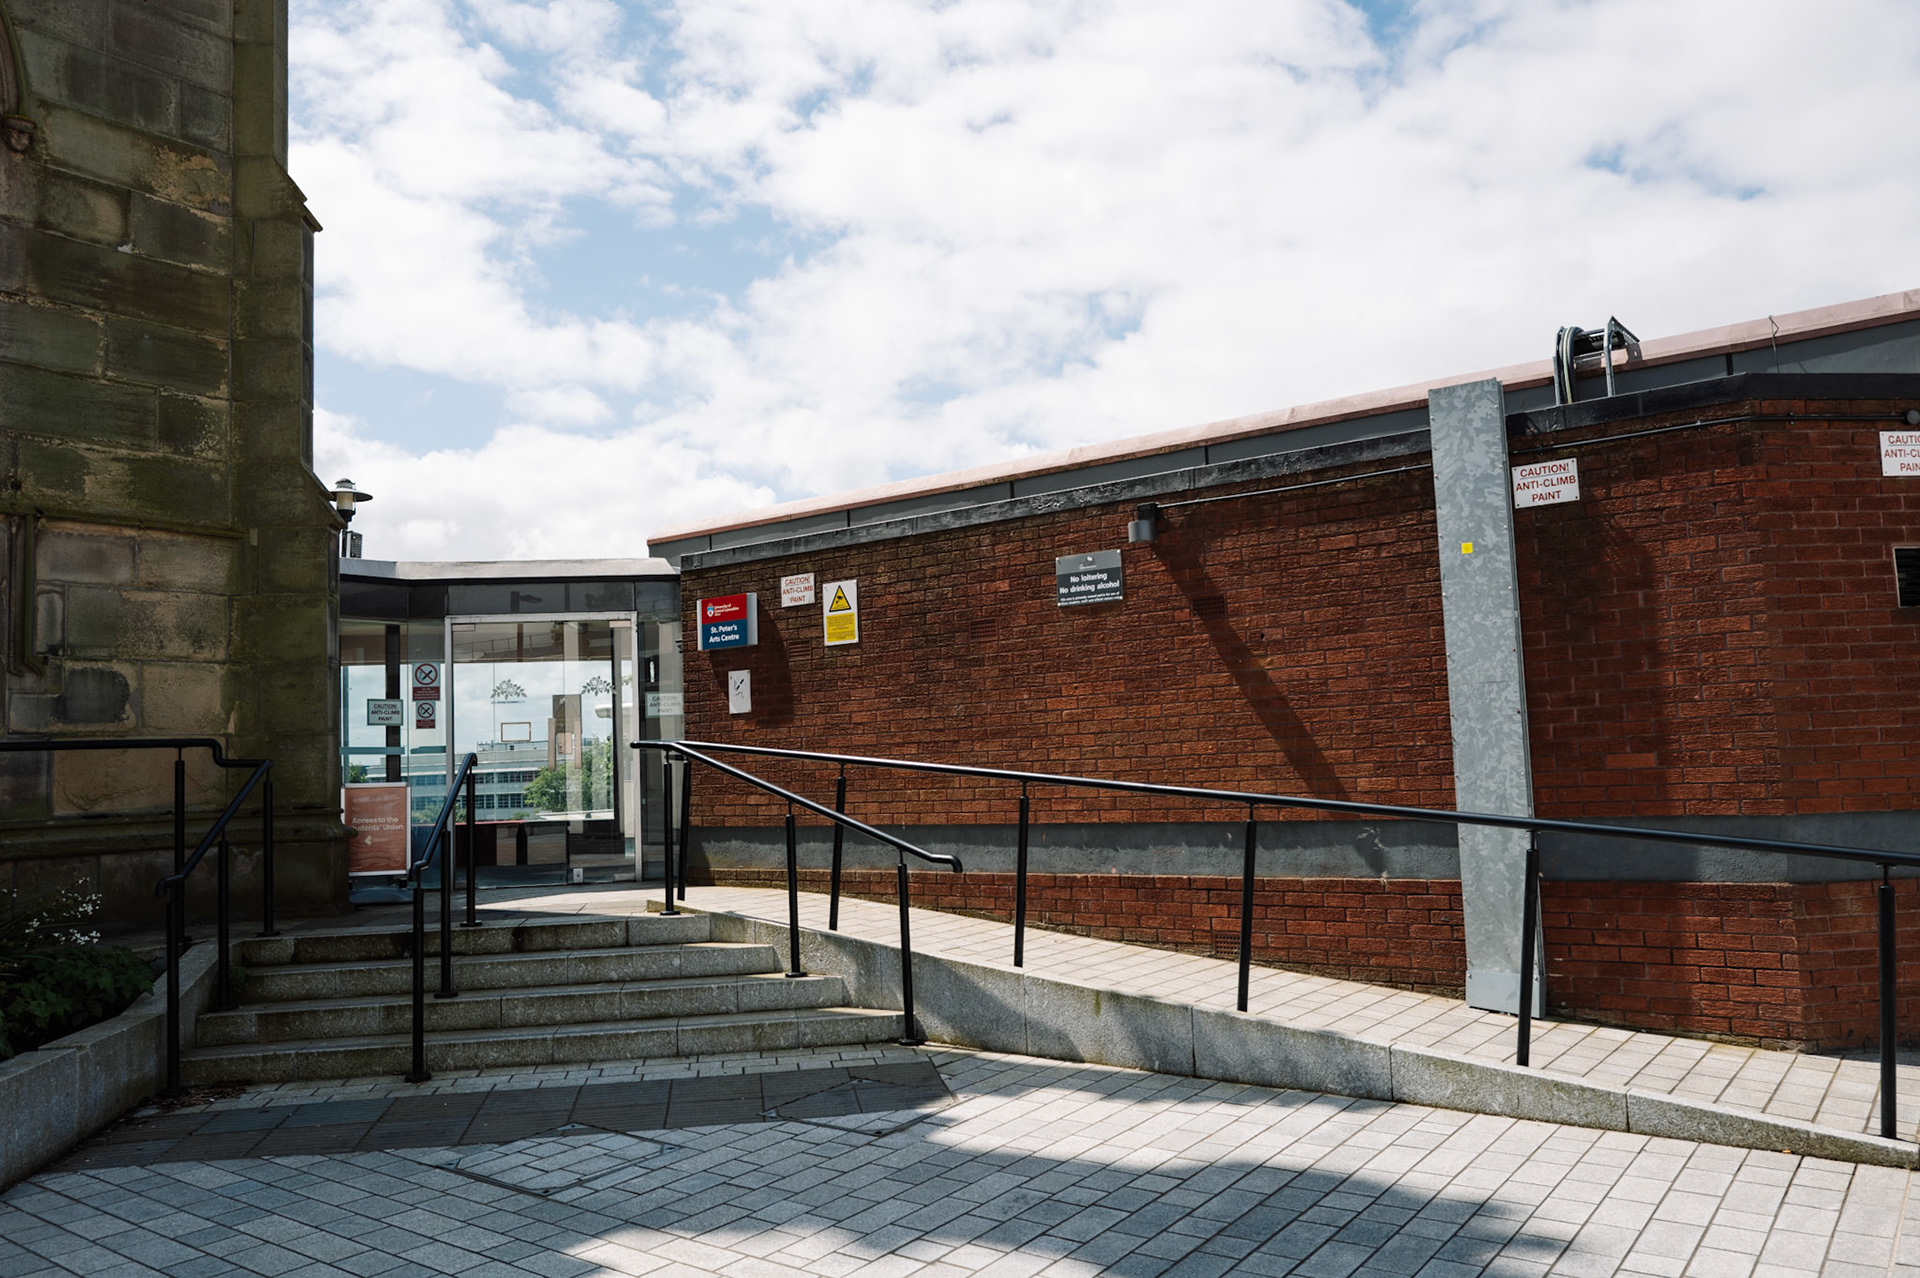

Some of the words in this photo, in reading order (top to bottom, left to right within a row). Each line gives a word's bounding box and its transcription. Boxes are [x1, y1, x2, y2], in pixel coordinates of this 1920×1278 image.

[1520, 462, 1570, 478] CAUTION!
[1516, 475, 1576, 492] ANTI-CLIMB
[1532, 490, 1562, 502] PAINT
[784, 576, 810, 586] CAUTION!
[1080, 572, 1108, 582] loitering
[782, 585, 814, 595] ANTI-CLIMB
[1070, 584, 1096, 592] drinking
[1096, 580, 1120, 590] alcohol
[790, 596, 806, 604] PAINT
[719, 624, 738, 632] Peter's
